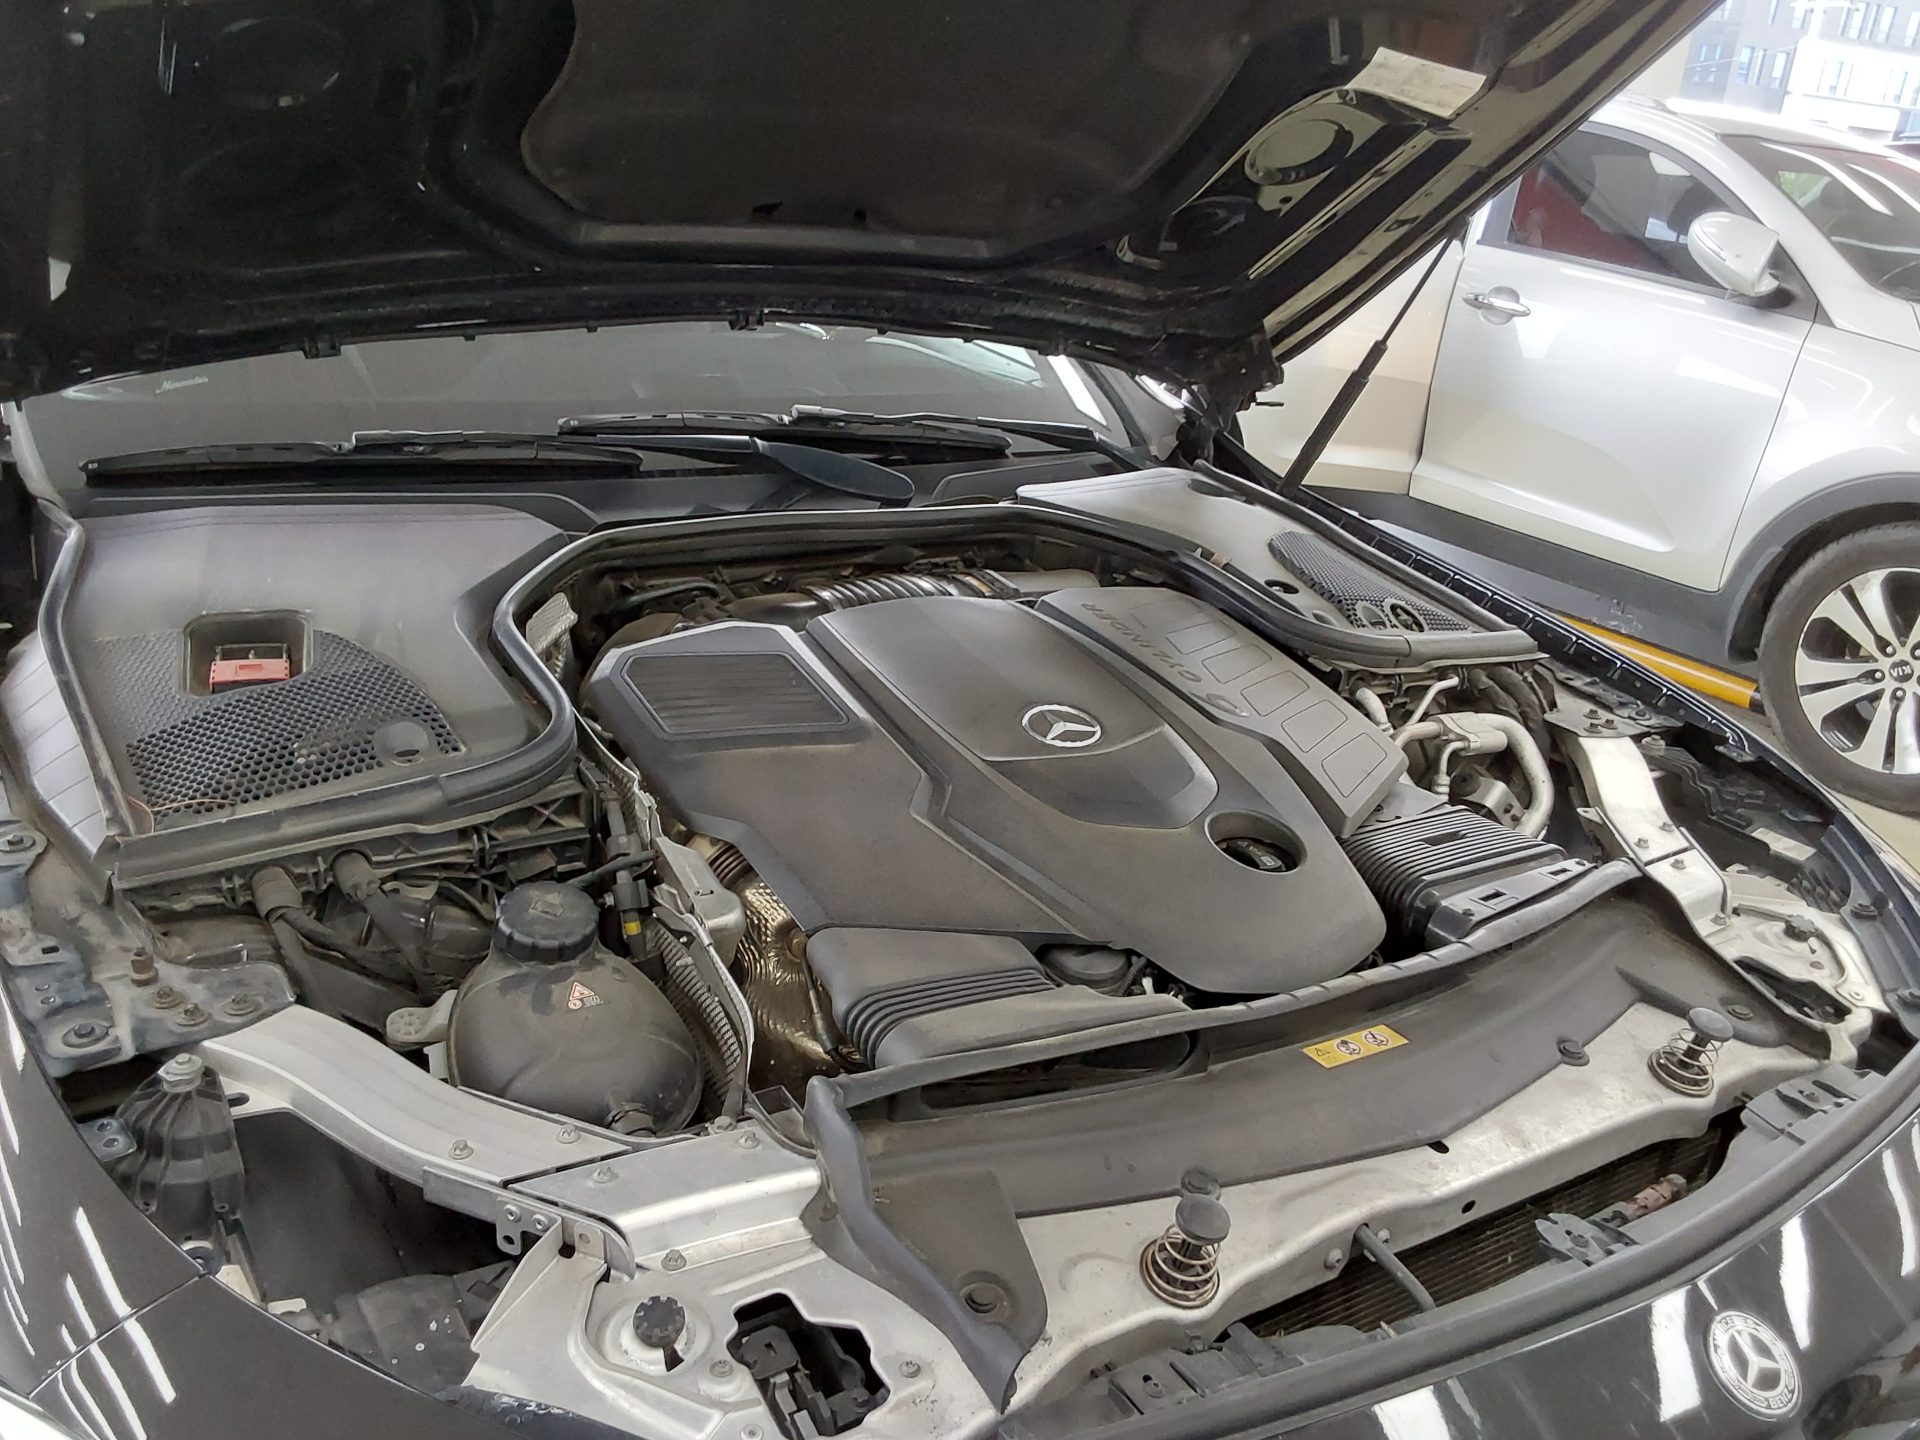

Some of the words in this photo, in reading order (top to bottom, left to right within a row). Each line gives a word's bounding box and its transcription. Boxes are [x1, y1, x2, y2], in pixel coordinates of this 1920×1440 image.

[1080, 602, 1202, 683] CYLINDER
[1890, 664, 1912, 678] KIA
[1768, 1387, 1793, 1409] BENZ
